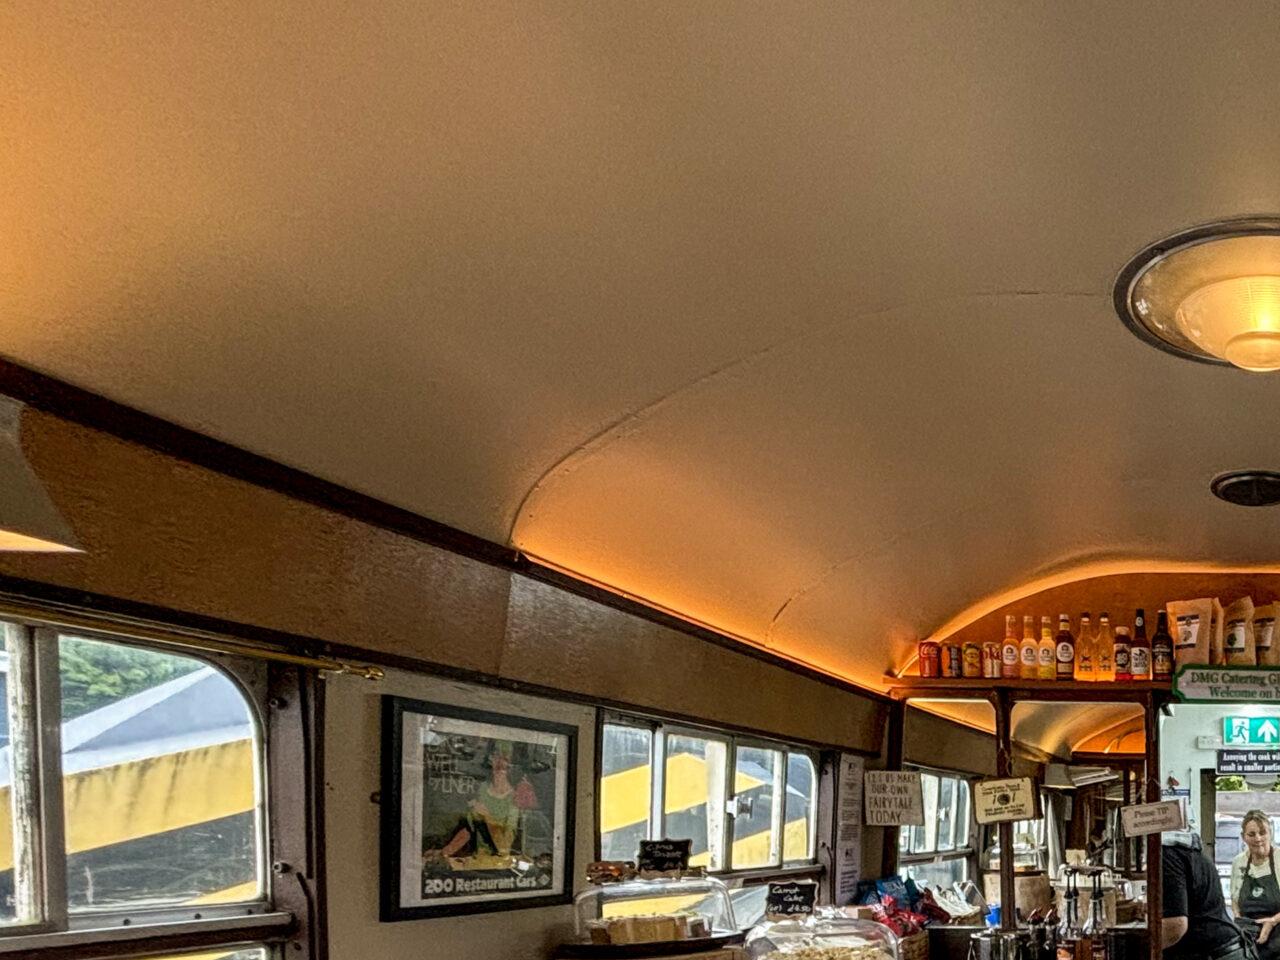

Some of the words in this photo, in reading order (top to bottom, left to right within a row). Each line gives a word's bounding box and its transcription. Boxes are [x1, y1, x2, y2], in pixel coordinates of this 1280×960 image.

[1191, 672, 1219, 684] DMG
[1221, 672, 1265, 686] Catering
[1209, 686, 1257, 698] Welcome
[1259, 689, 1273, 699] on
[1222, 752, 1247, 762] Annoying
[1248, 752, 1257, 761] the
[1258, 752, 1270, 761] cook
[1220, 763, 1235, 771] result
[1237, 763, 1242, 771] in
[1244, 763, 1263, 771] smaller
[890, 785, 908, 795] OWN
[869, 810, 902, 824] TODAY
[425, 878, 452, 894] 200
[456, 876, 514, 892] Restaurant
[516, 874, 537, 888] Cars
